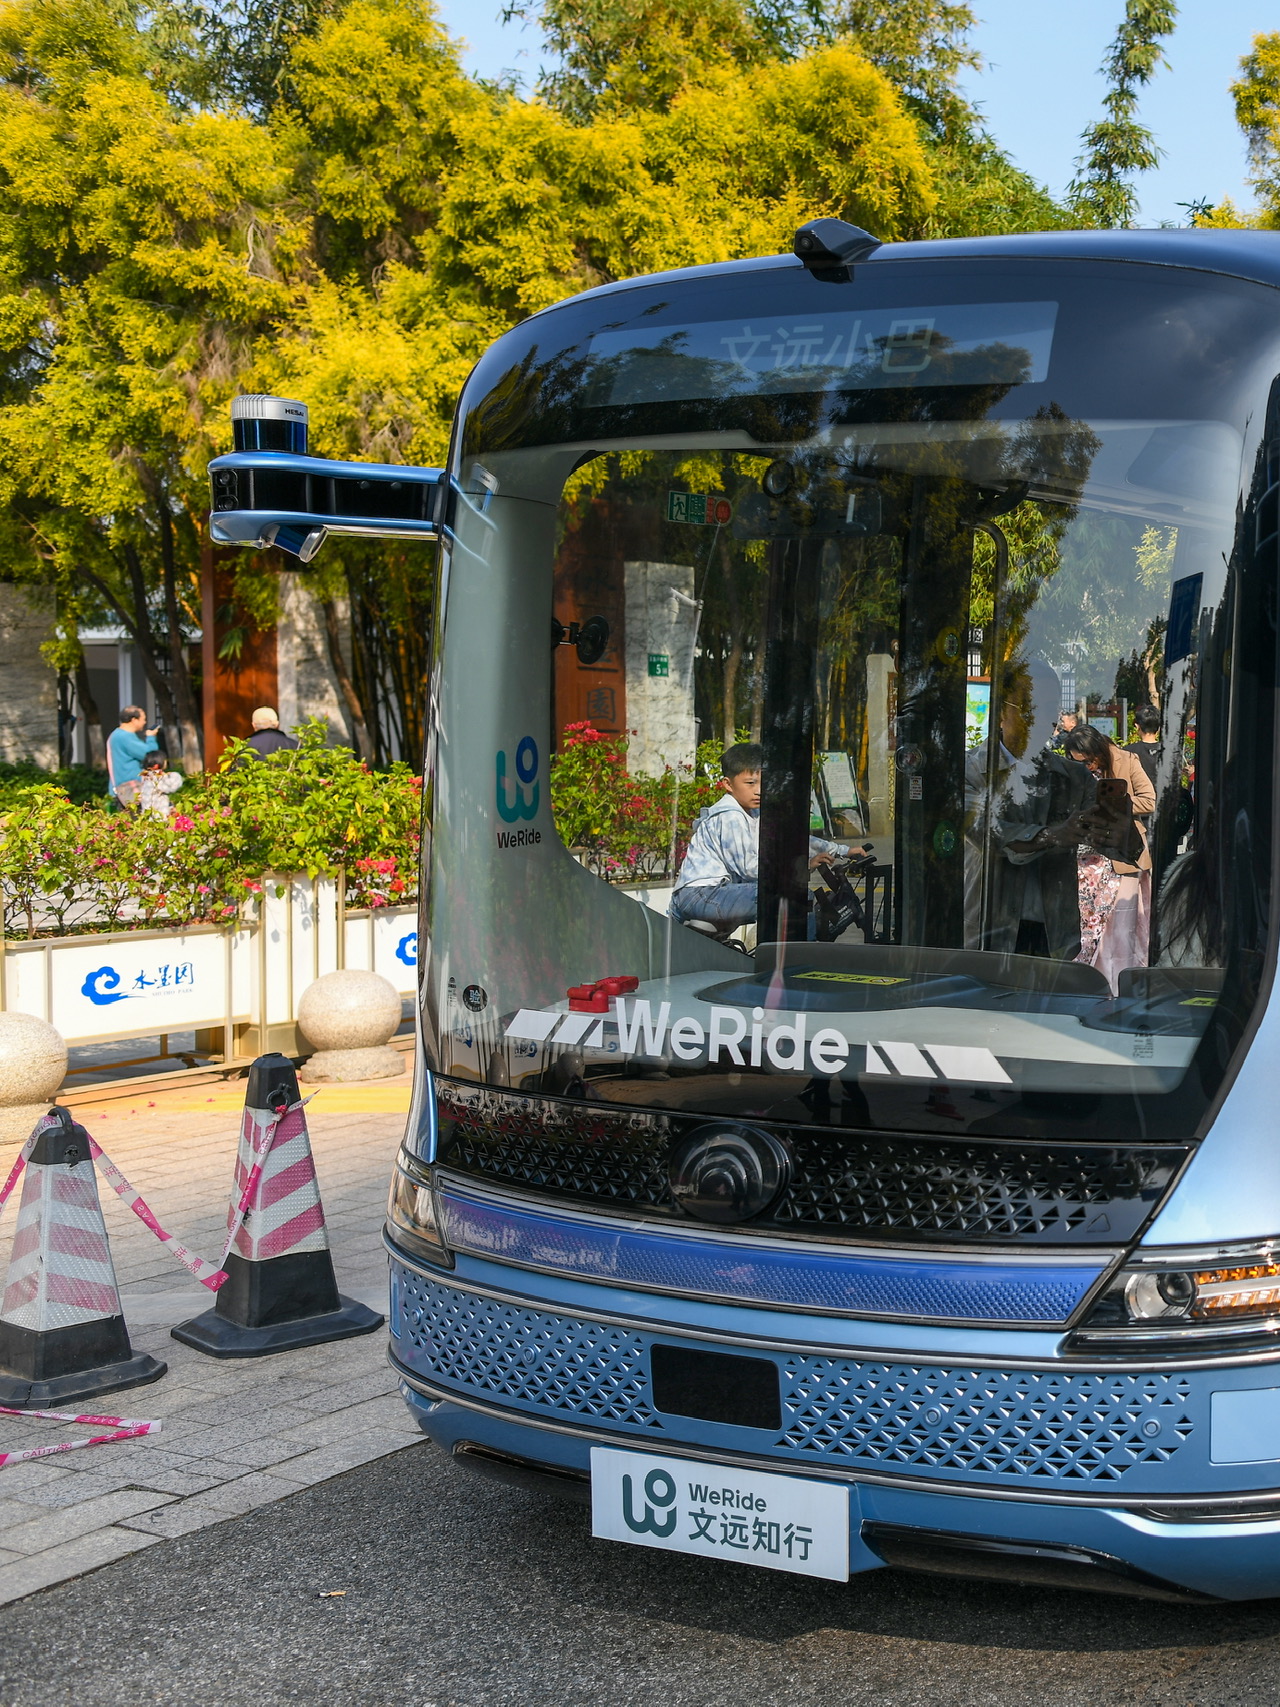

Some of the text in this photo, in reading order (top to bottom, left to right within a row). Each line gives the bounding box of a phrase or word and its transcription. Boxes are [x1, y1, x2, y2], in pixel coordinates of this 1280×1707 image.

[713, 317, 936, 380] 文远小巴
[497, 828, 541, 848] WeRide
[615, 997, 850, 1074] WeRide
[688, 1483, 767, 1513] WeRide
[688, 1507, 813, 1561] 文远知行
